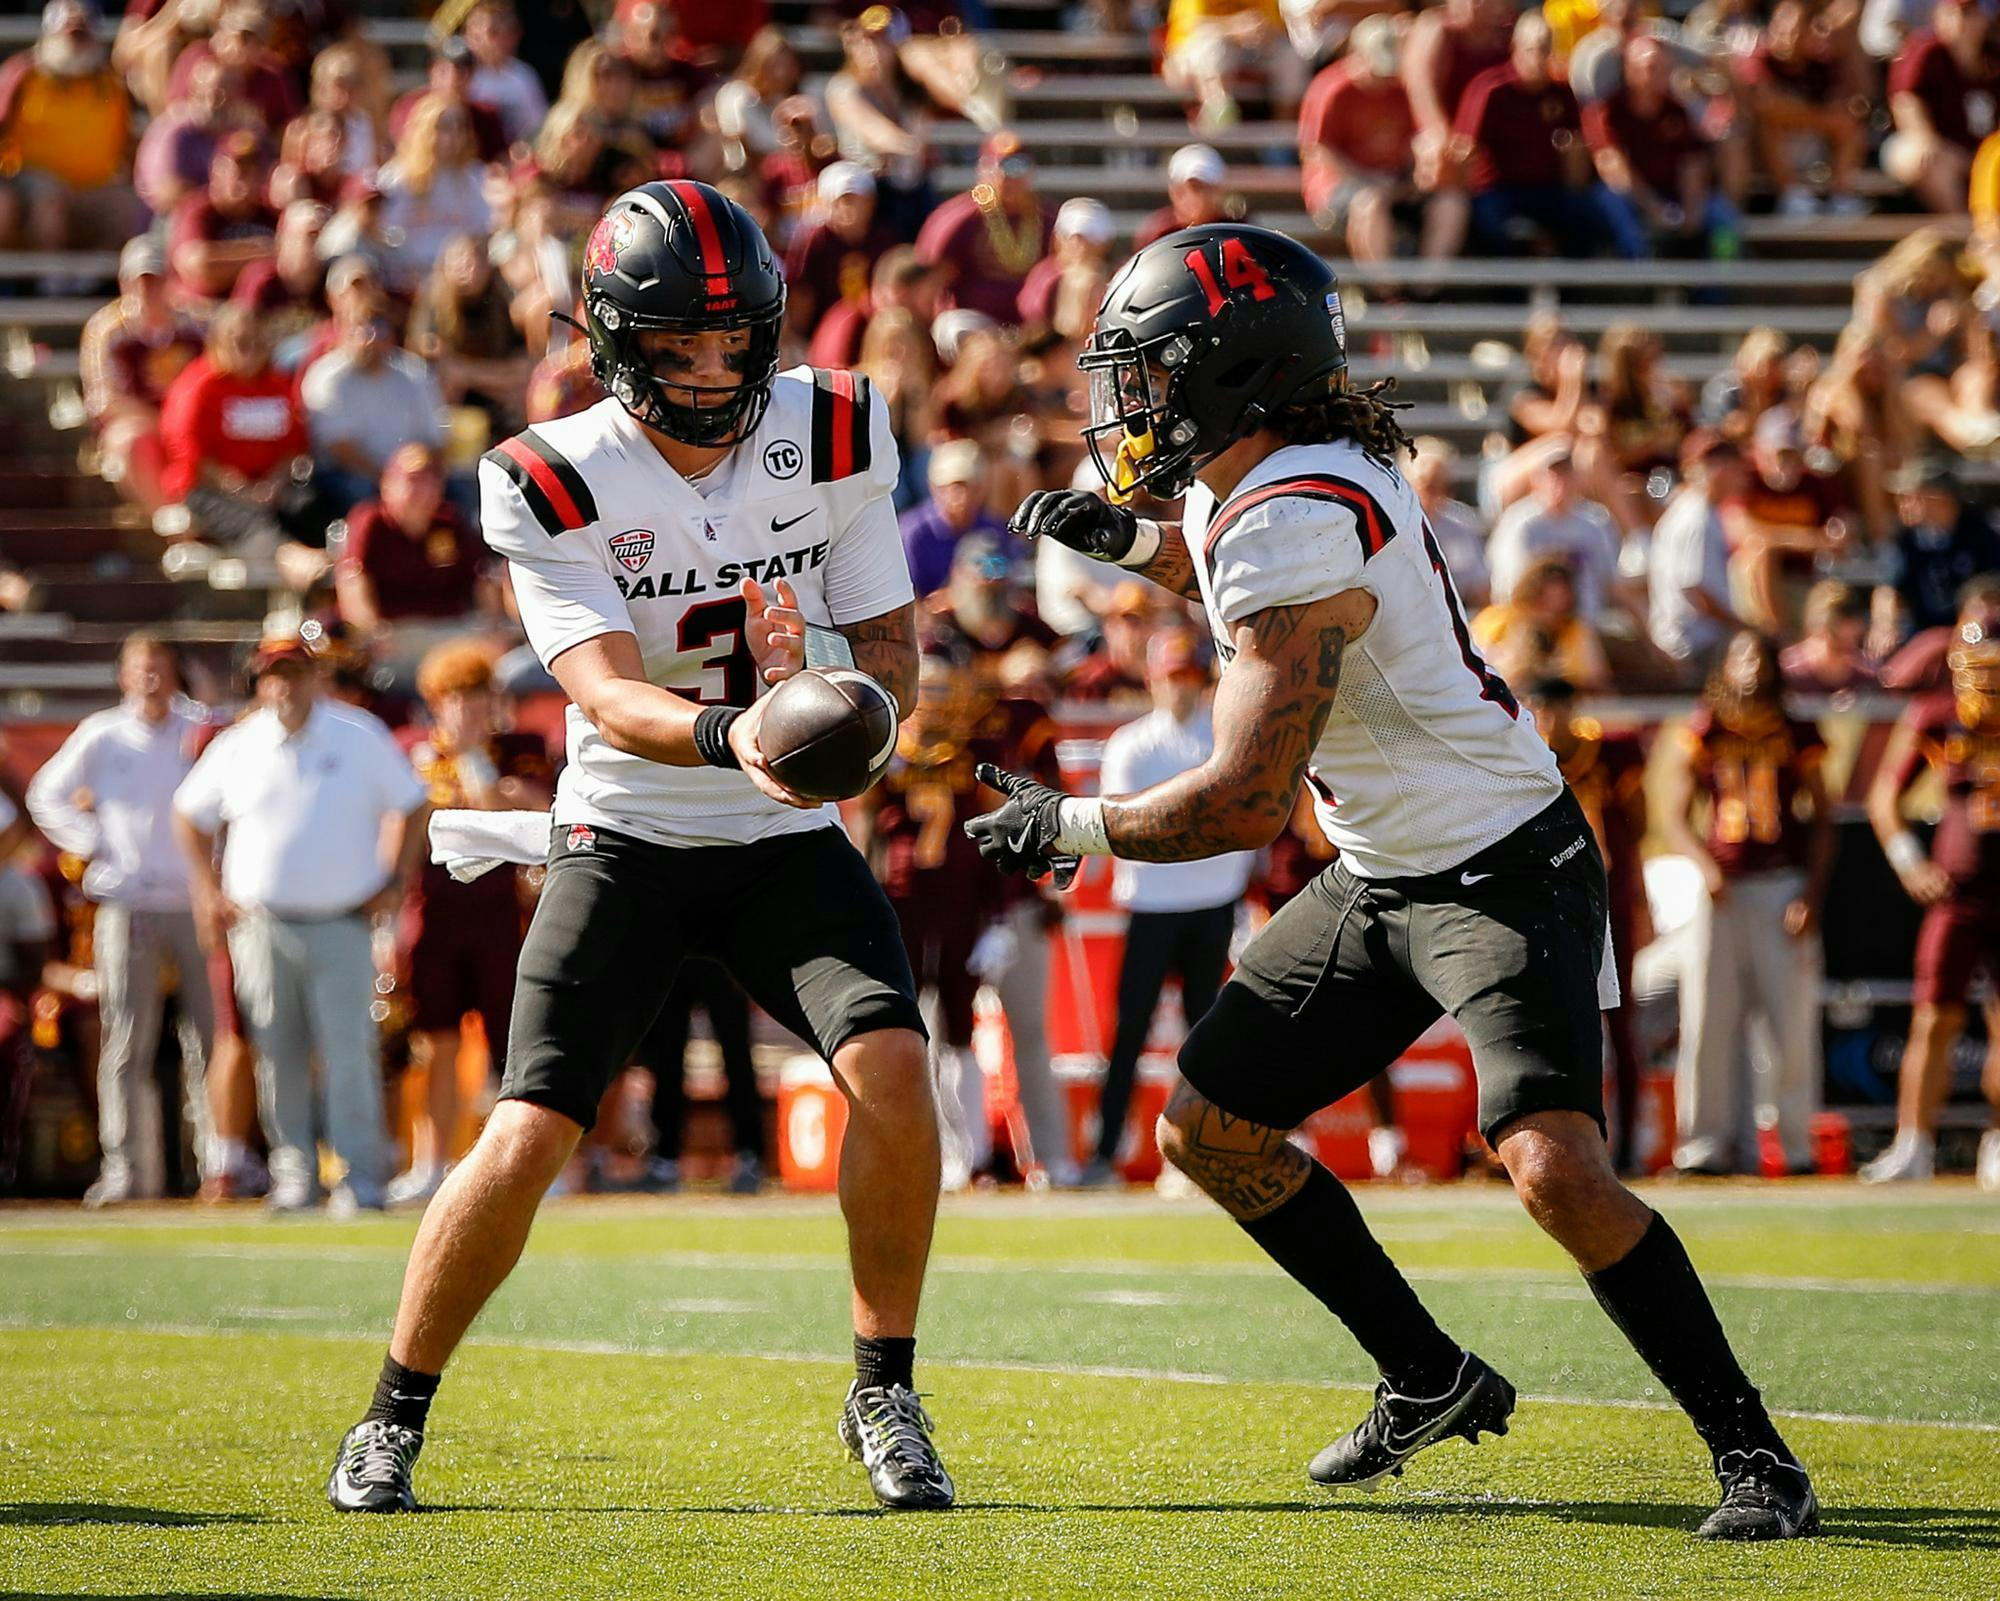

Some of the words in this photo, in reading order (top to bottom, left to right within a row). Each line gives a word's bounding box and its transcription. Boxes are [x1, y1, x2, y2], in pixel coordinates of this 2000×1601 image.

[1184, 238, 1276, 318] 14
[768, 448, 797, 472] TC
[614, 541, 653, 557] MAC
[715, 538, 829, 588] STATE
[666, 595, 757, 708] 3
